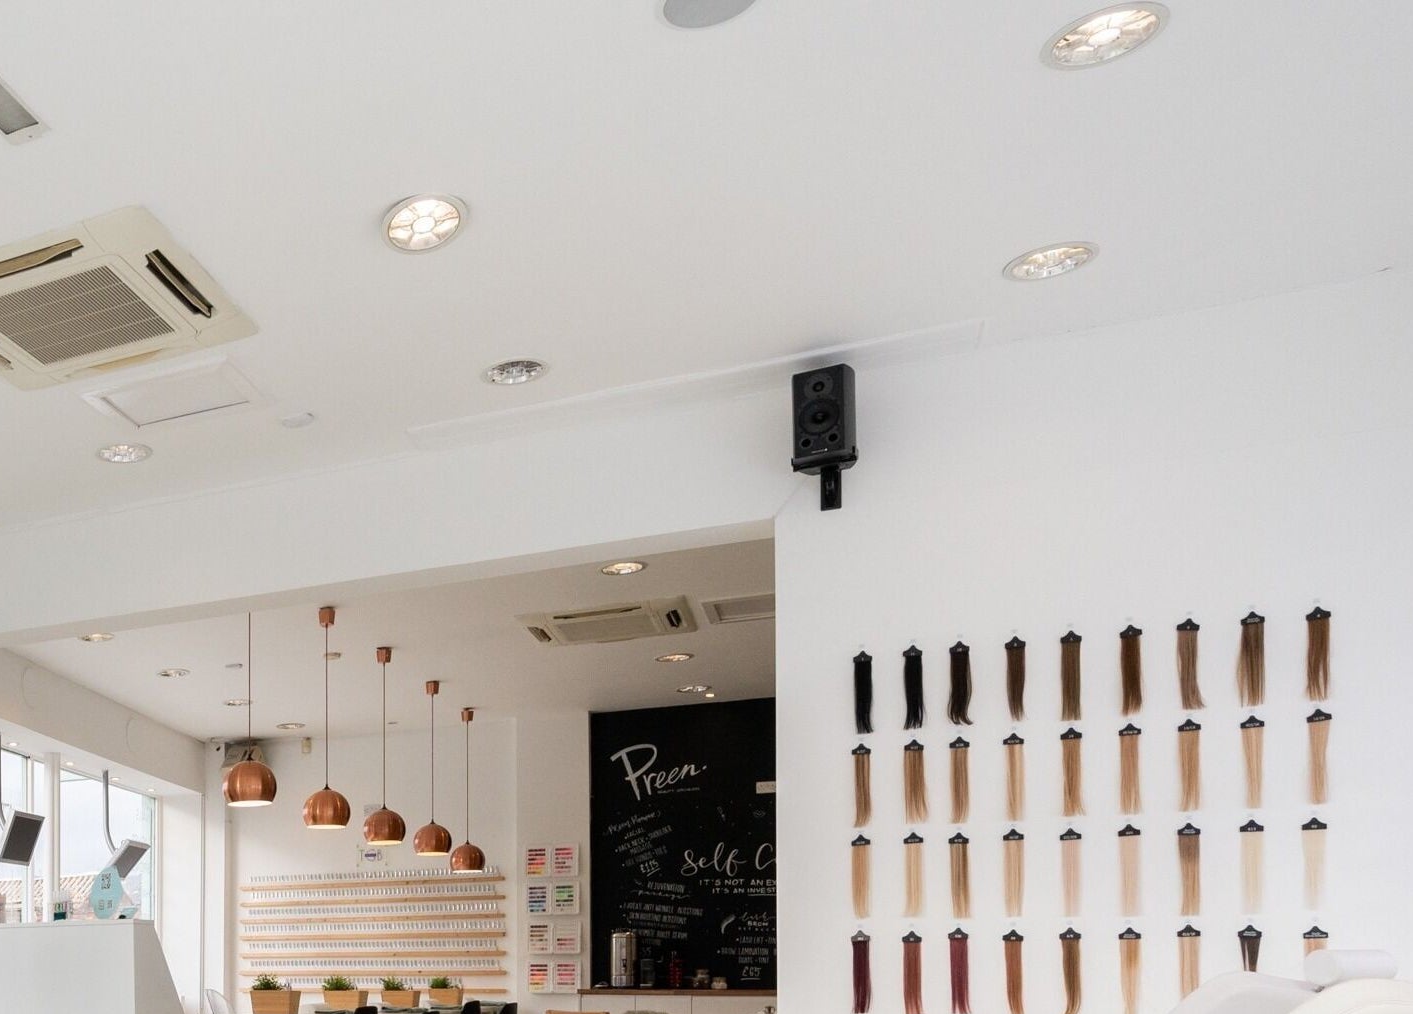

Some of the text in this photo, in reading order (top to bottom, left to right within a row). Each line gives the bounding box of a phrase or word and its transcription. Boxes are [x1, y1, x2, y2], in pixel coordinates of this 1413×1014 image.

[610, 743, 707, 801] Preen.
[681, 842, 747, 877] Self
[700, 879, 721, 887] IT'S
[725, 879, 745, 887] NOT
[750, 879, 764, 887] AN
[712, 887, 776, 895] IT'S AN INVEST
